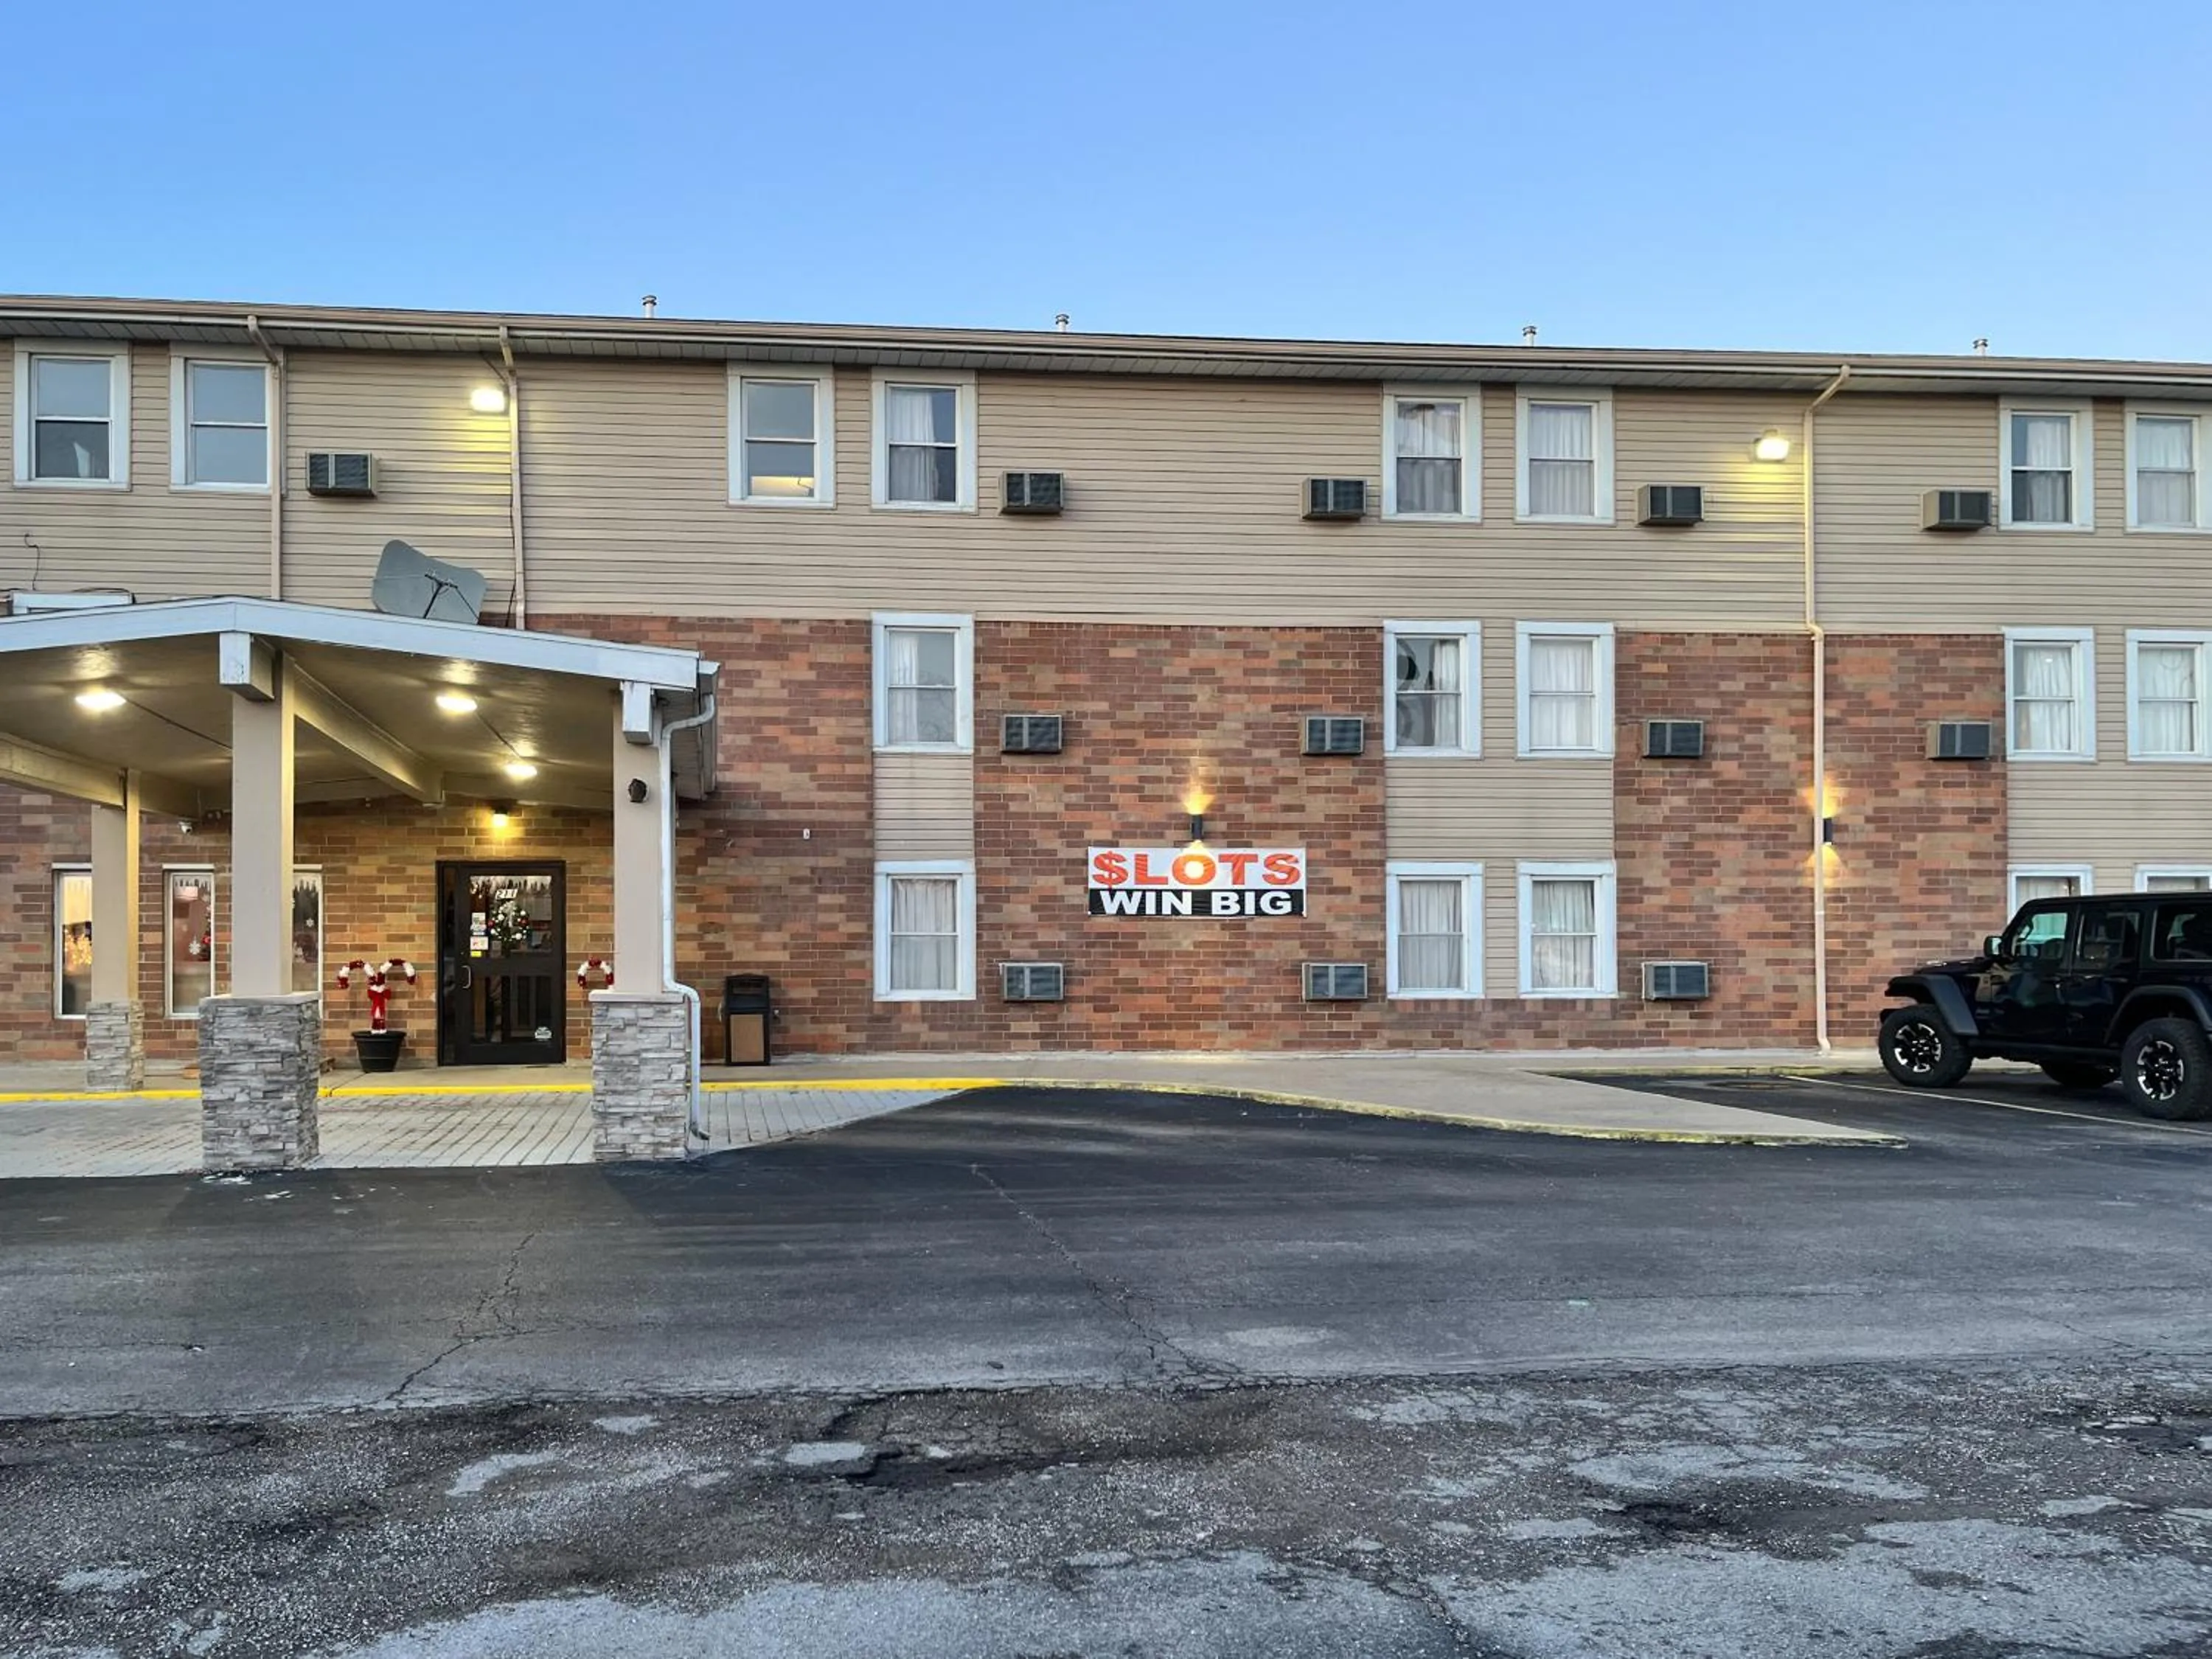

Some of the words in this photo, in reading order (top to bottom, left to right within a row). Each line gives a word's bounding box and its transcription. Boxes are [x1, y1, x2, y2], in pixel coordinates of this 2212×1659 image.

[1092, 851, 1301, 888] $LOTS
[1099, 891, 1192, 915] WIN
[1211, 891, 1292, 915] BIG
